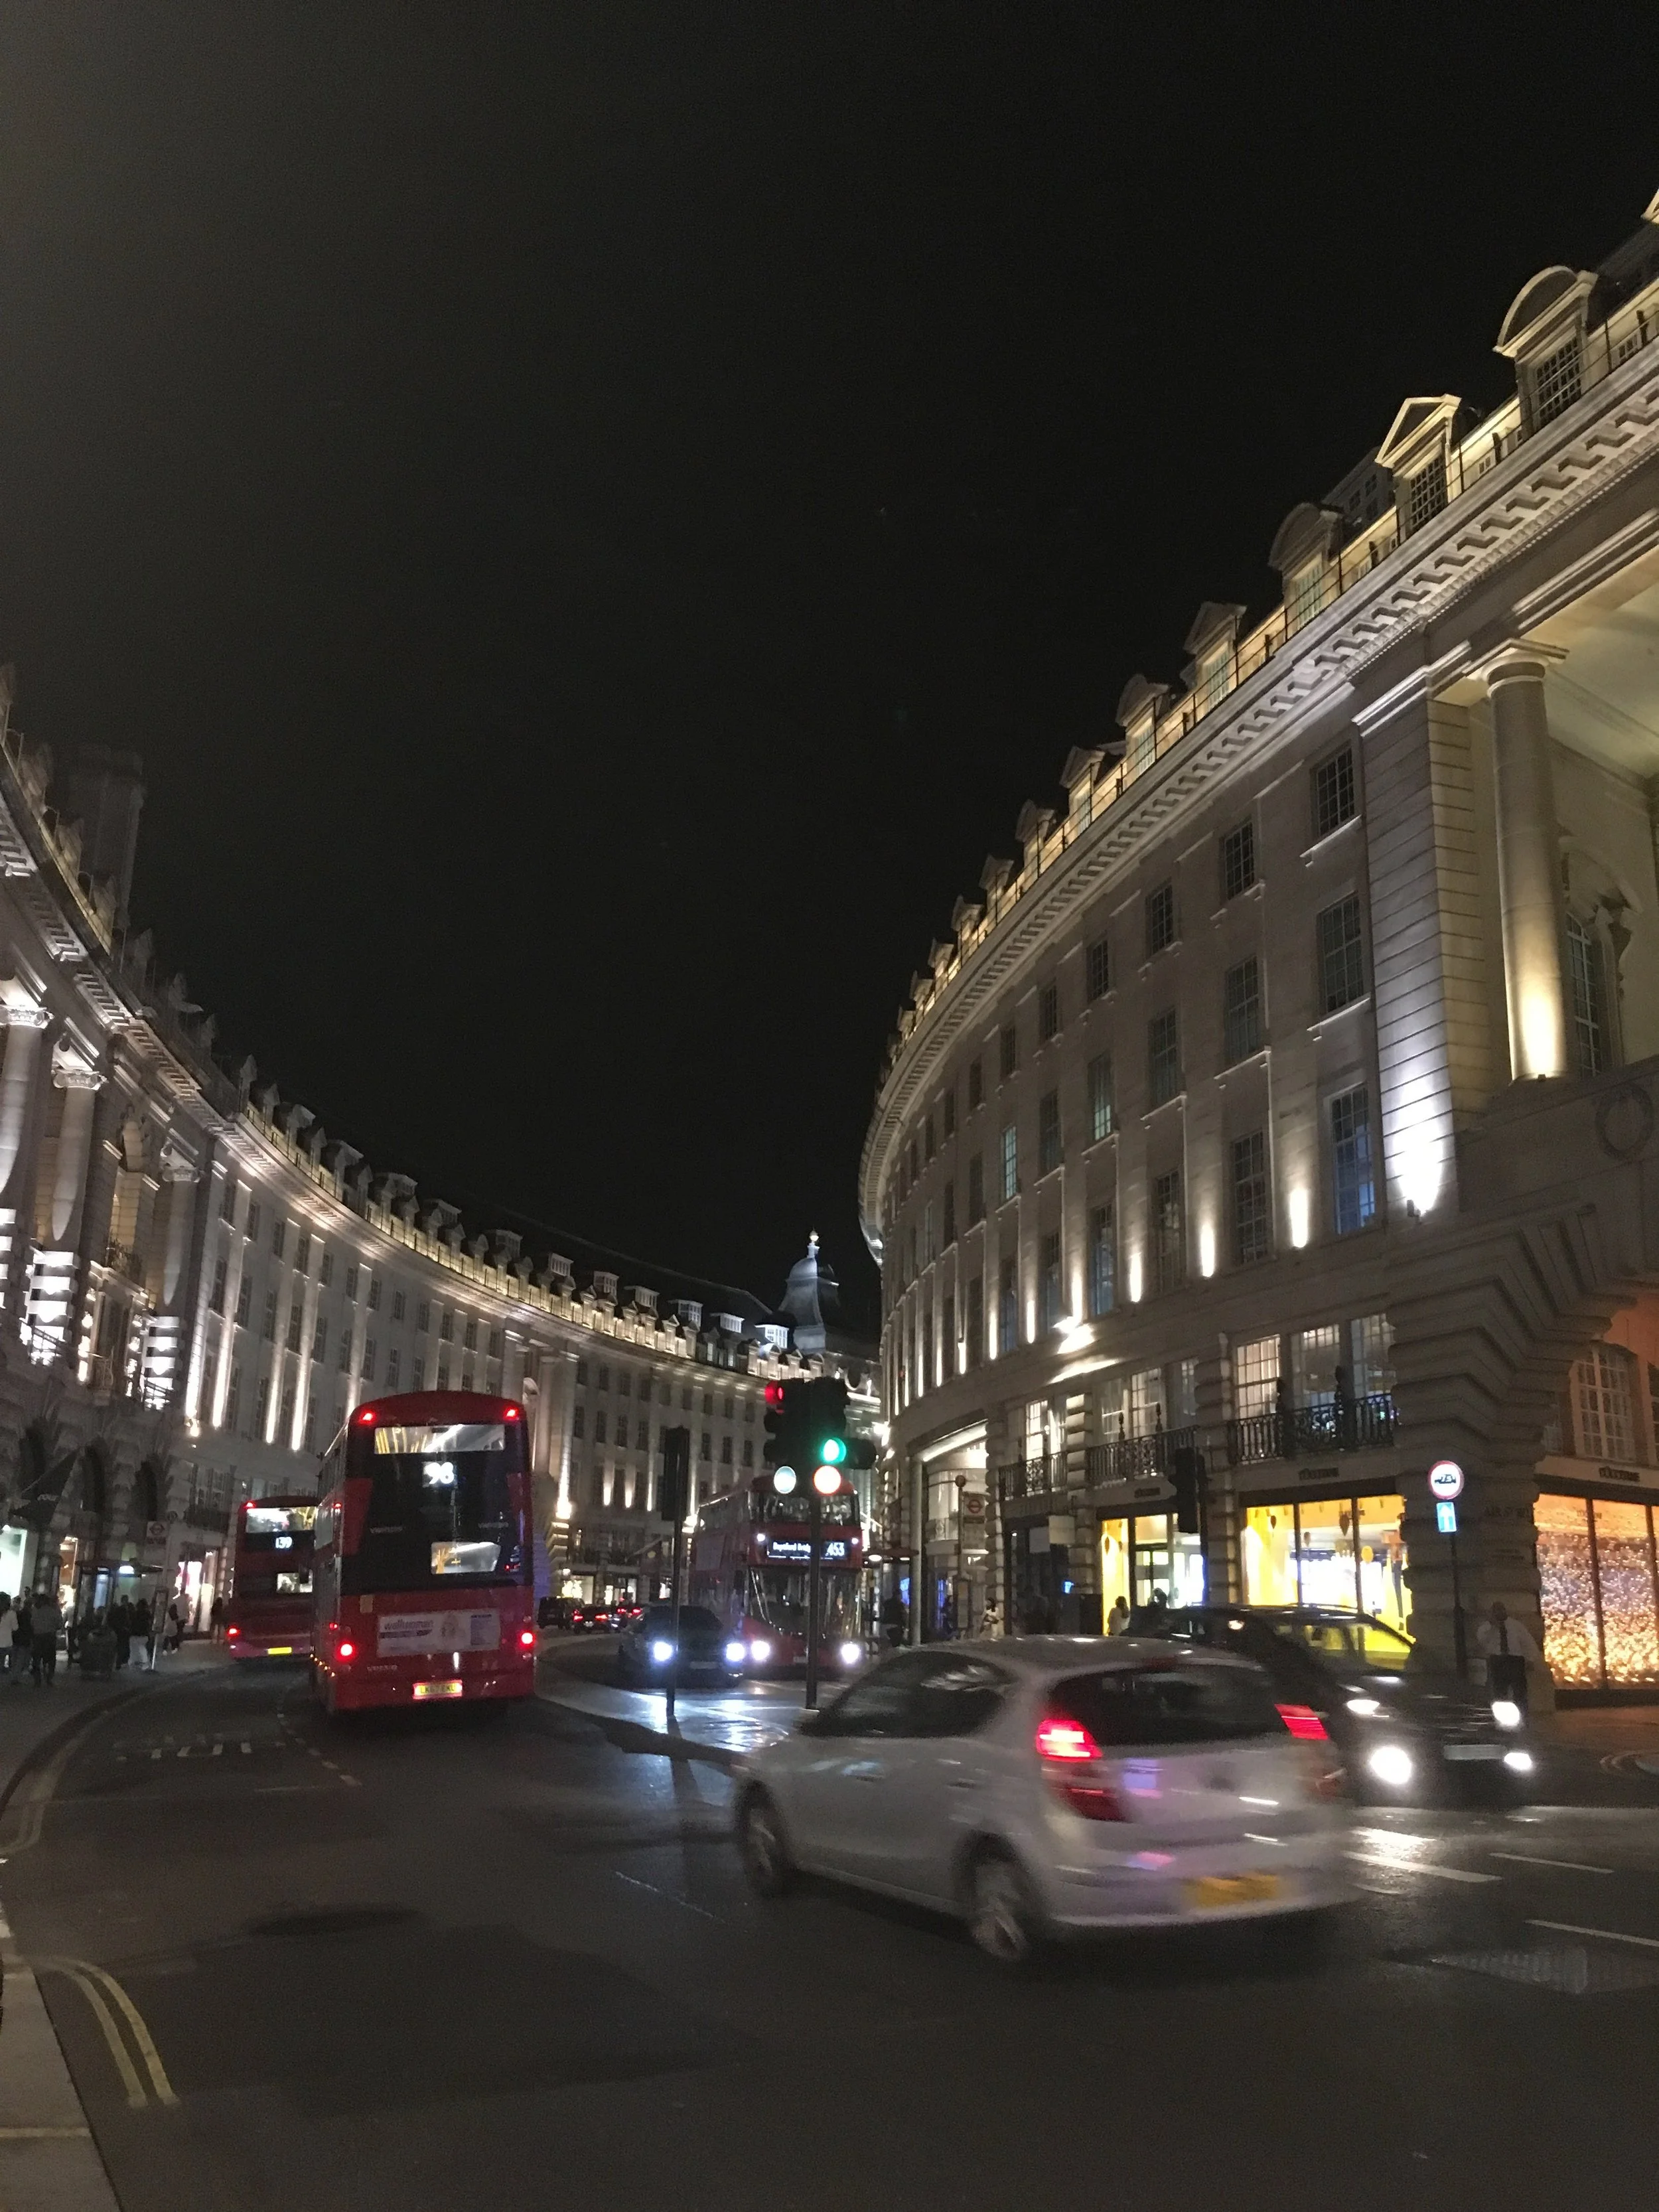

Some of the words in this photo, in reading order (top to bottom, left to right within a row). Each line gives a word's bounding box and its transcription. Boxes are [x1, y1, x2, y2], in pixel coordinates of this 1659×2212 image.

[425, 1462, 455, 1485] 98
[275, 1536, 293, 1549] 139
[825, 1542, 845, 1556] 453
